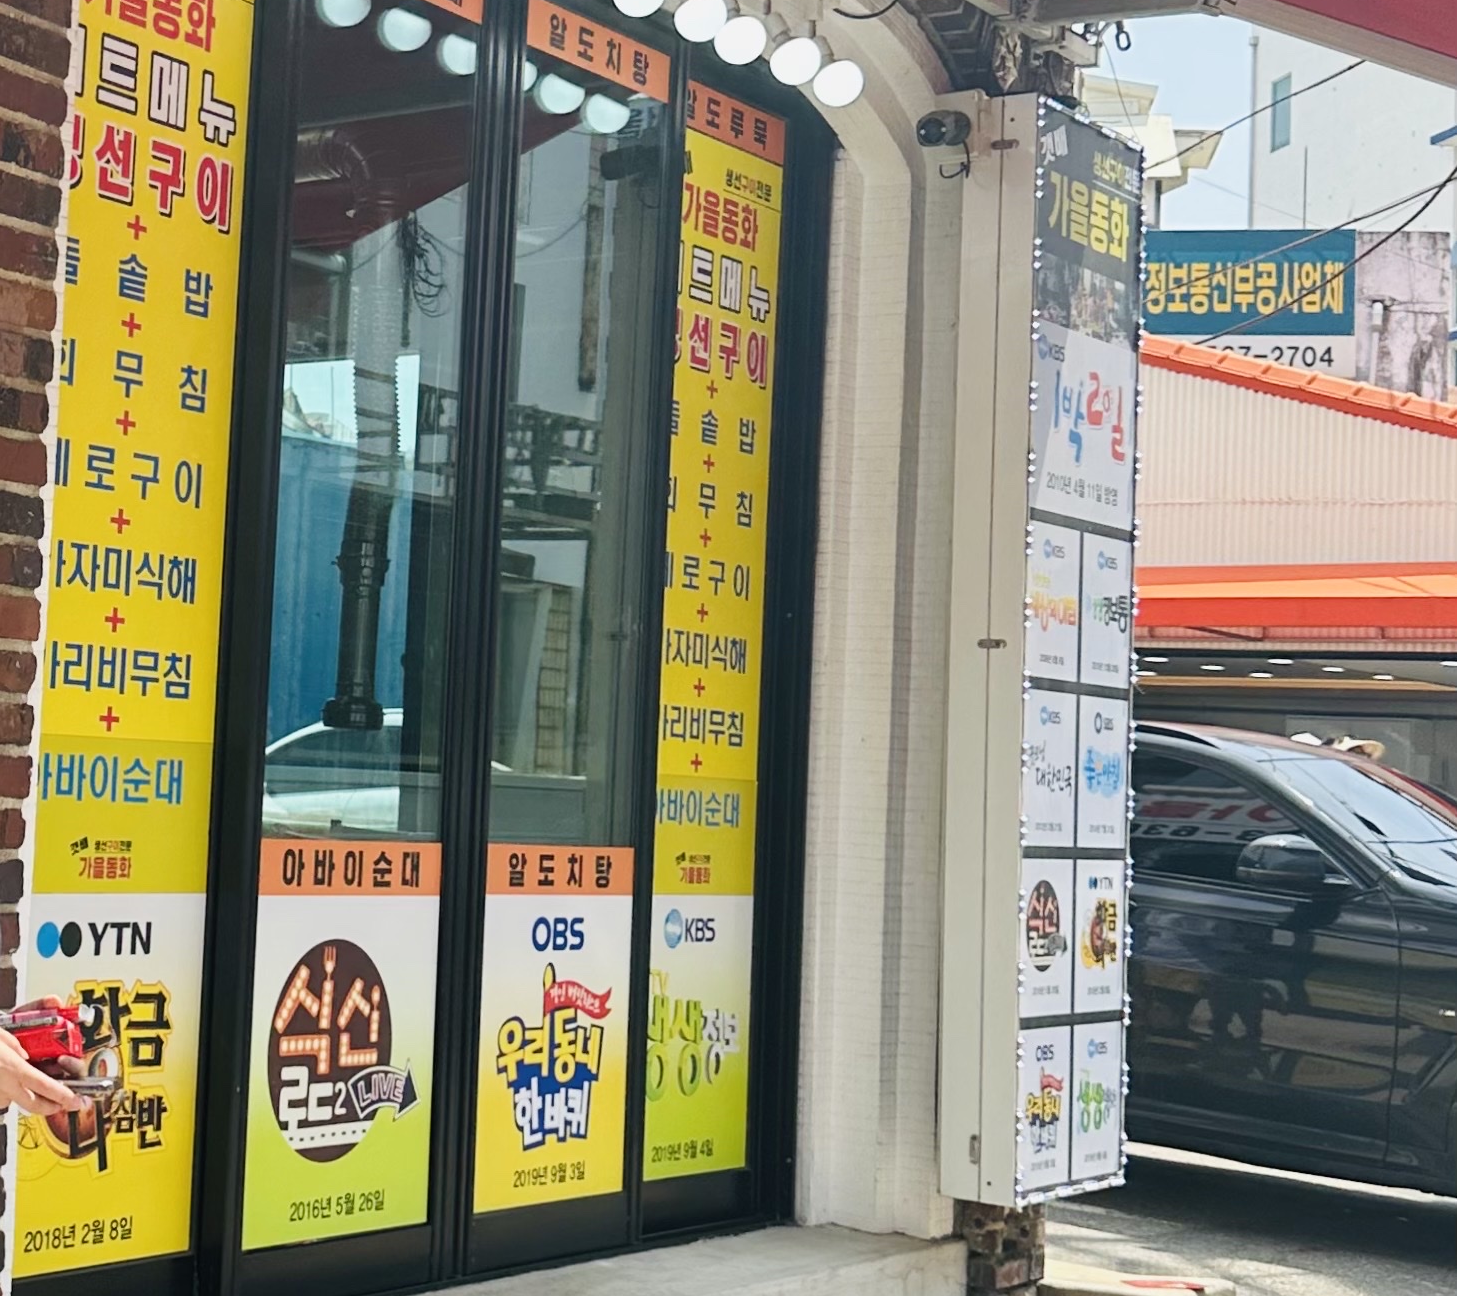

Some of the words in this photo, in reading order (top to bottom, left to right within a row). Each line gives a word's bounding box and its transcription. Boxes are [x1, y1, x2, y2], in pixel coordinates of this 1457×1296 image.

[549, 12, 649, 87] 알도치탕
[682, 181, 759, 252] 가을동화
[1048, 171, 1129, 262] 가을동화
[676, 240, 770, 322] 트메뉴
[1145, 261, 1344, 314] 정보통신부공사업체
[1207, 346, 1334, 367] -2704
[79, 857, 131, 879] 가을동화
[282, 848, 420, 888] 아바이순대
[508, 852, 612, 889] 알도치탕
[88, 921, 152, 956] YTN
[532, 916, 585, 951] OBS
[685, 917, 716, 943] KBS
[497, 1008, 603, 1083] 우리동네
[357, 1073, 404, 1105] LIVE
[513, 1166, 548, 1188] 2019년
[551, 1164, 567, 1184] 9월
[570, 1160, 585, 1181] 3일
[290, 1196, 331, 1222] 2016년
[335, 1194, 355, 1215] 5월
[359, 1189, 385, 1212] 26일
[24, 1225, 75, 1253] 2018년
[81, 1220, 105, 1245] 2월
[110, 1216, 133, 1242] 8일
